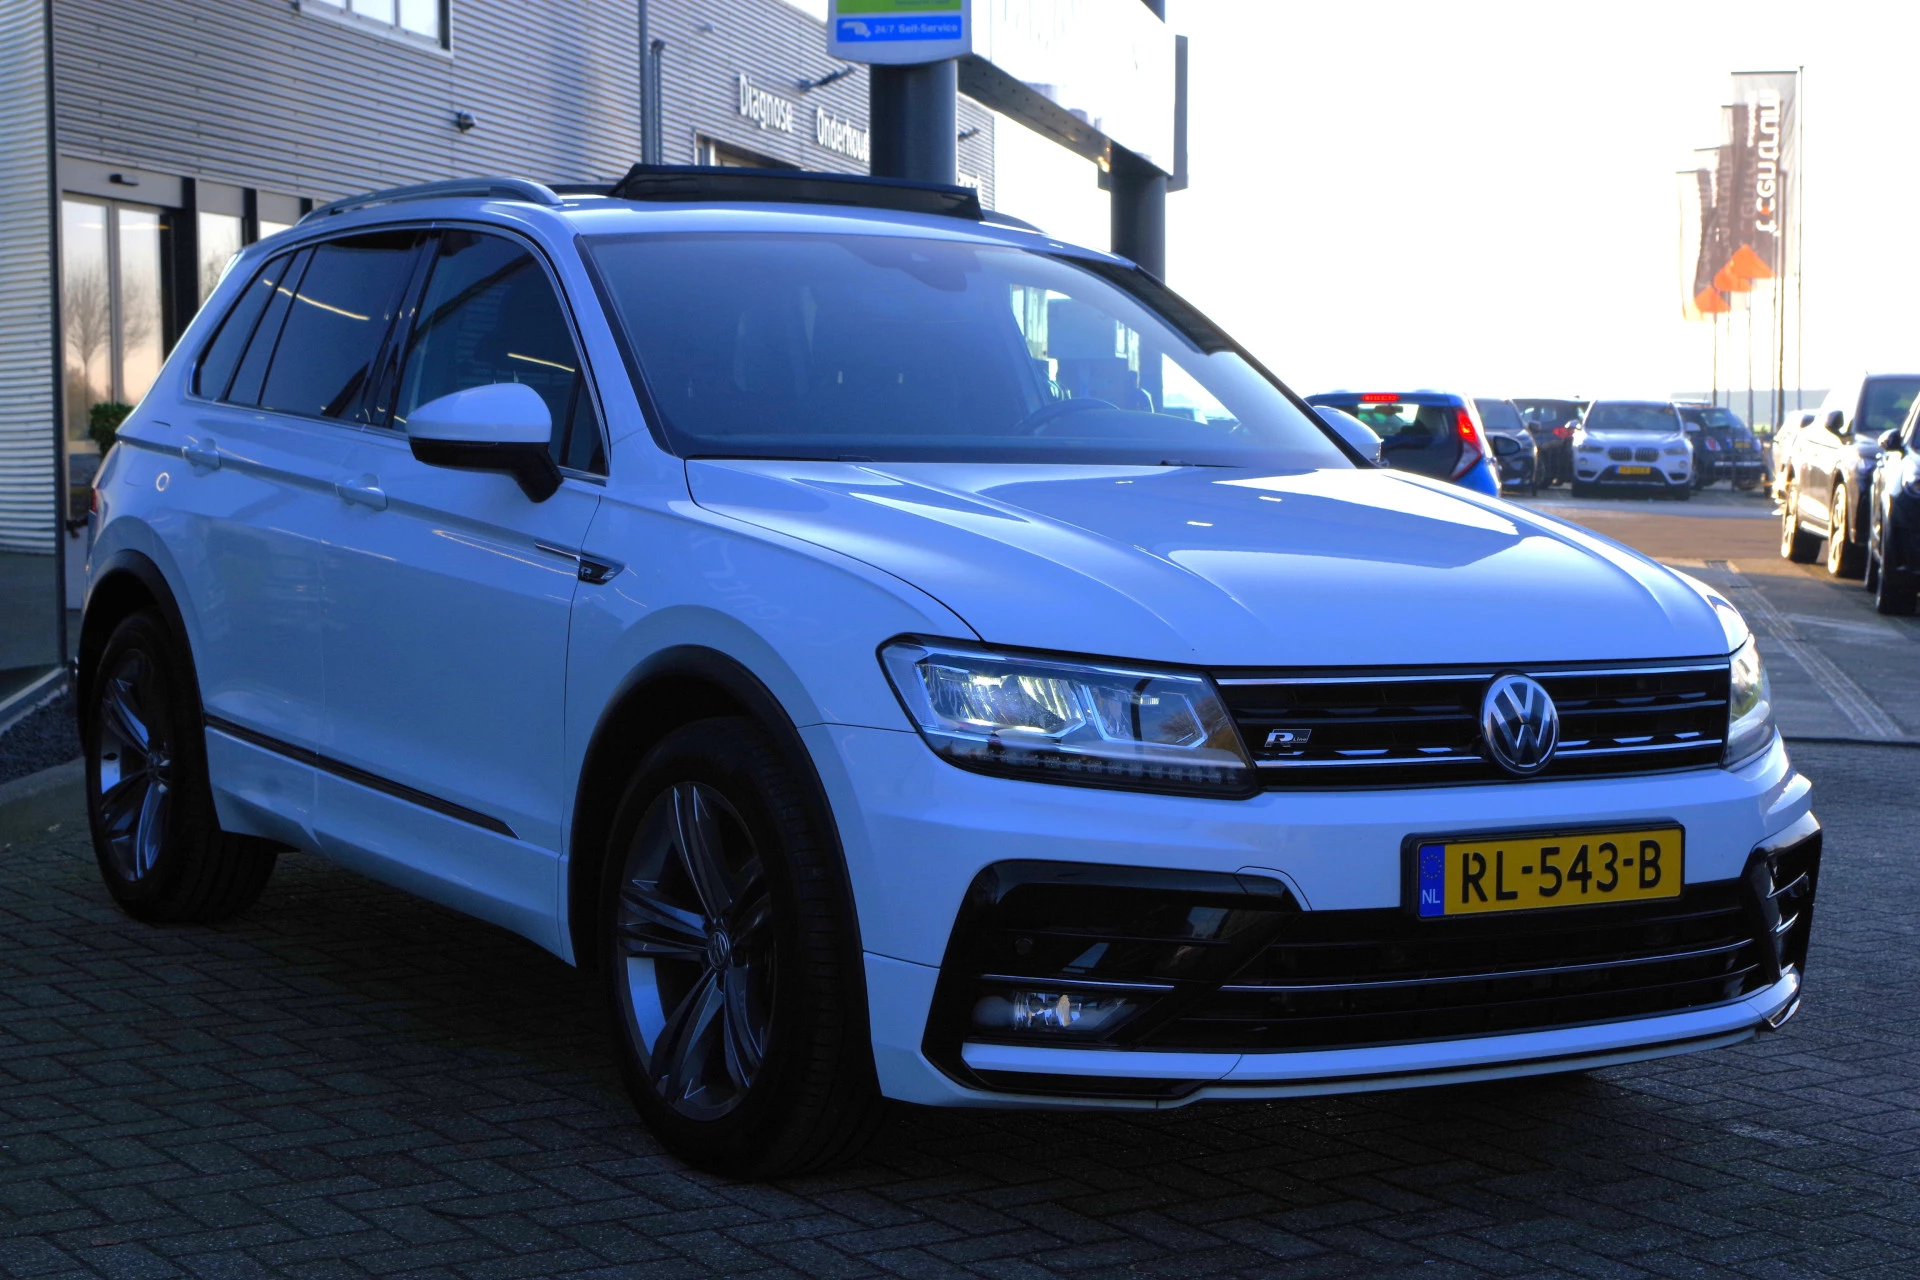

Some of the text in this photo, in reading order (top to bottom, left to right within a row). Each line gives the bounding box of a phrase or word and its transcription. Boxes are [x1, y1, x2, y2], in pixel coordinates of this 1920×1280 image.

[898, 23, 958, 34] Self-Service
[740, 73, 793, 133] Diagnose
[1461, 839, 1662, 904] RL-543-B
[1422, 888, 1440, 904] NL
